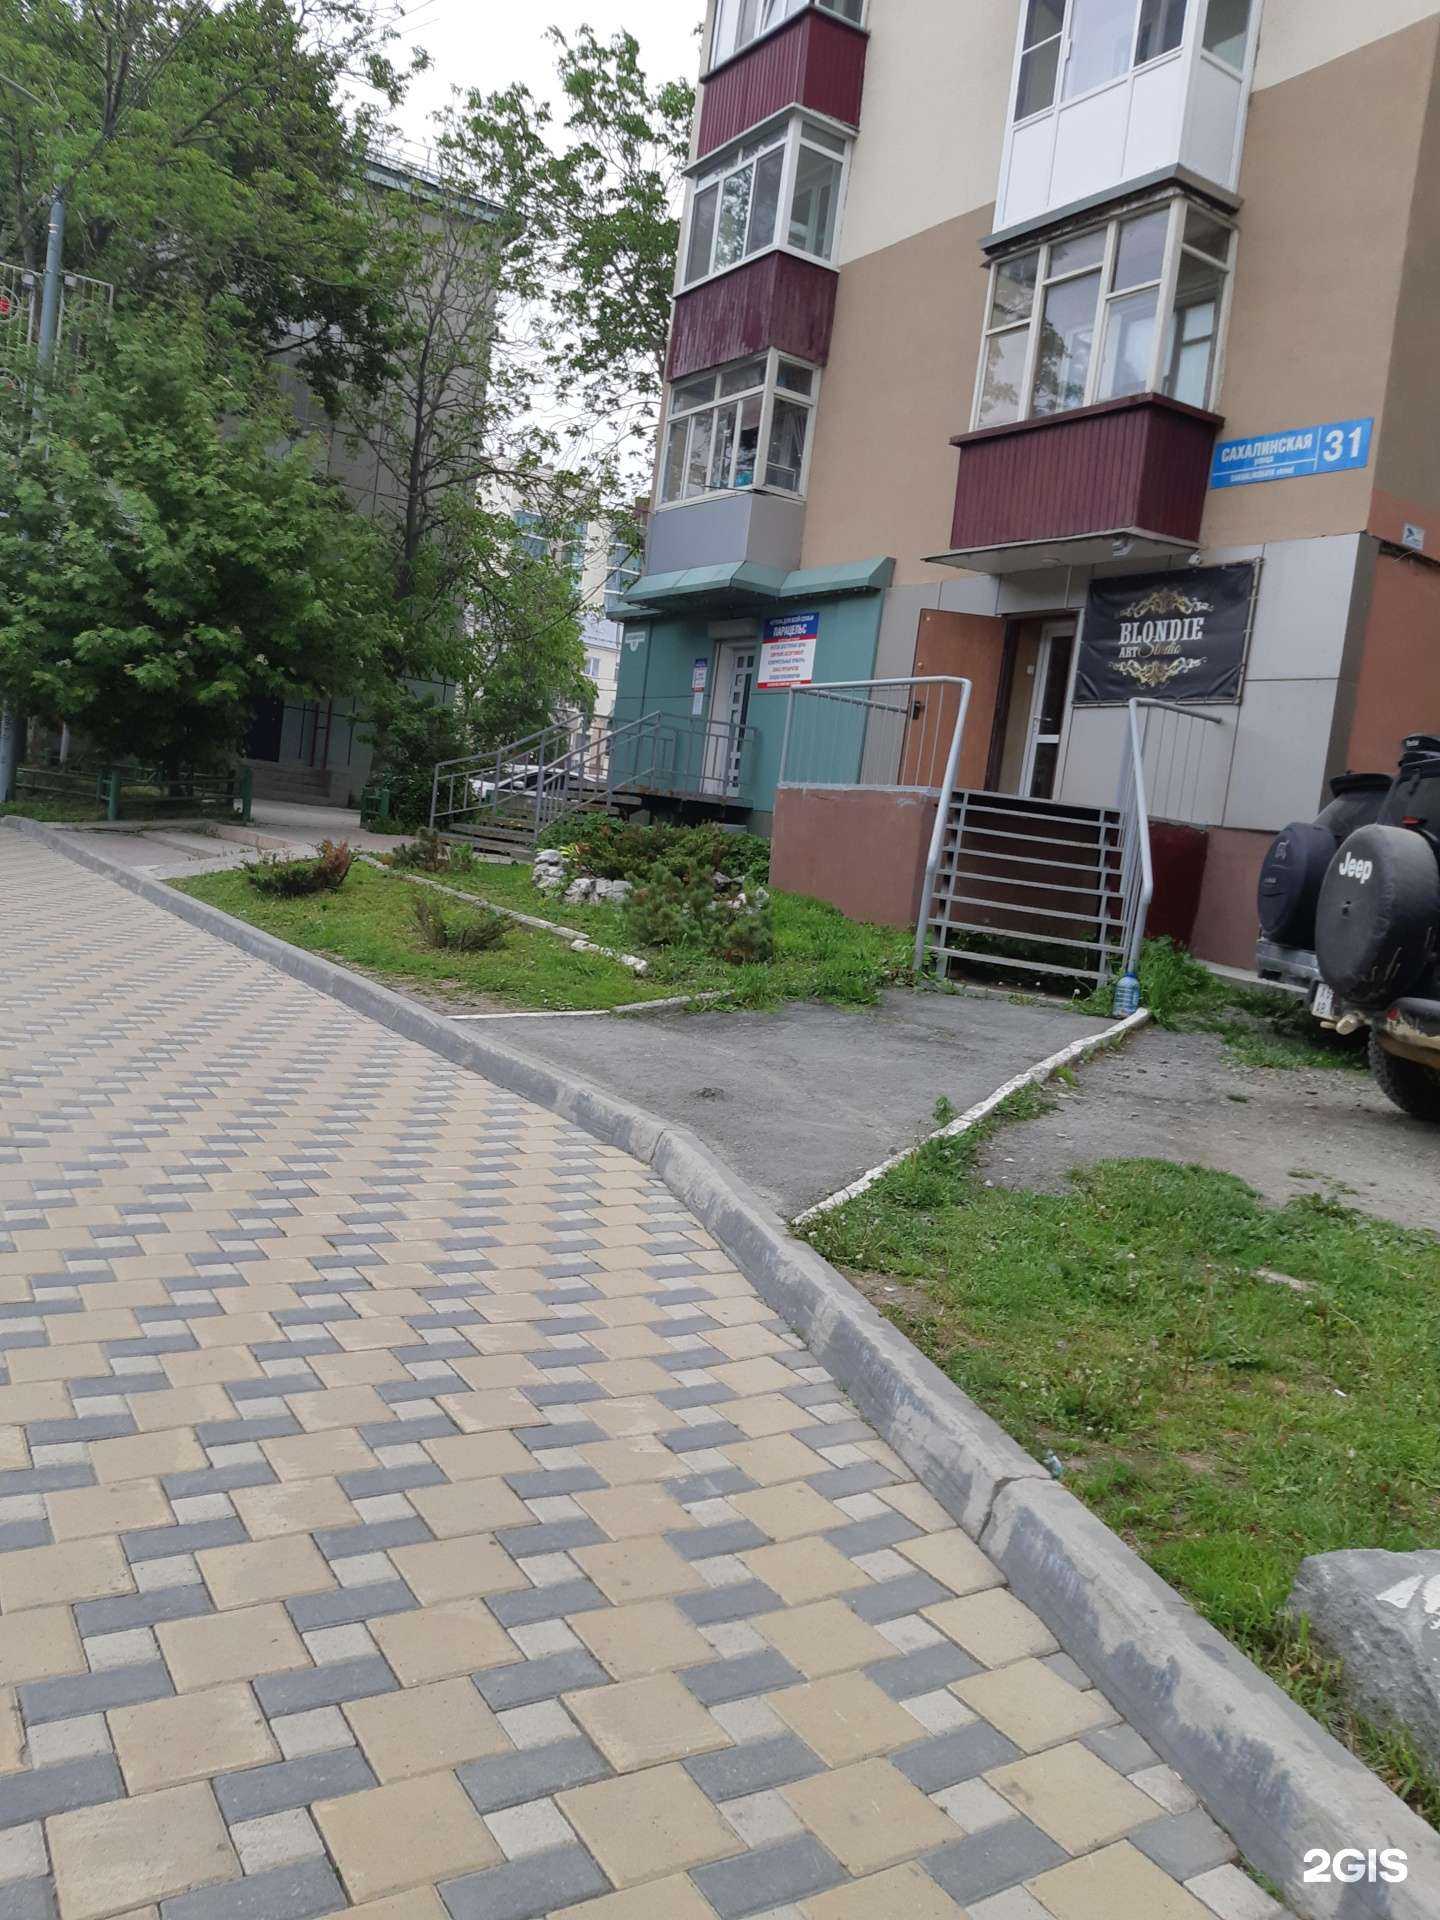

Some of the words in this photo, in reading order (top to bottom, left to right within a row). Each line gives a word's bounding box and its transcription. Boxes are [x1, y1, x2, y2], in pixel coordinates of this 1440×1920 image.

[1221, 433, 1312, 463] САХАЛИНСКАЯ
[1323, 427, 1362, 462] 31
[1118, 617, 1205, 645] BLONDIE
[1119, 646, 1138, 658] ART
[1339, 851, 1373, 884] Jeep
